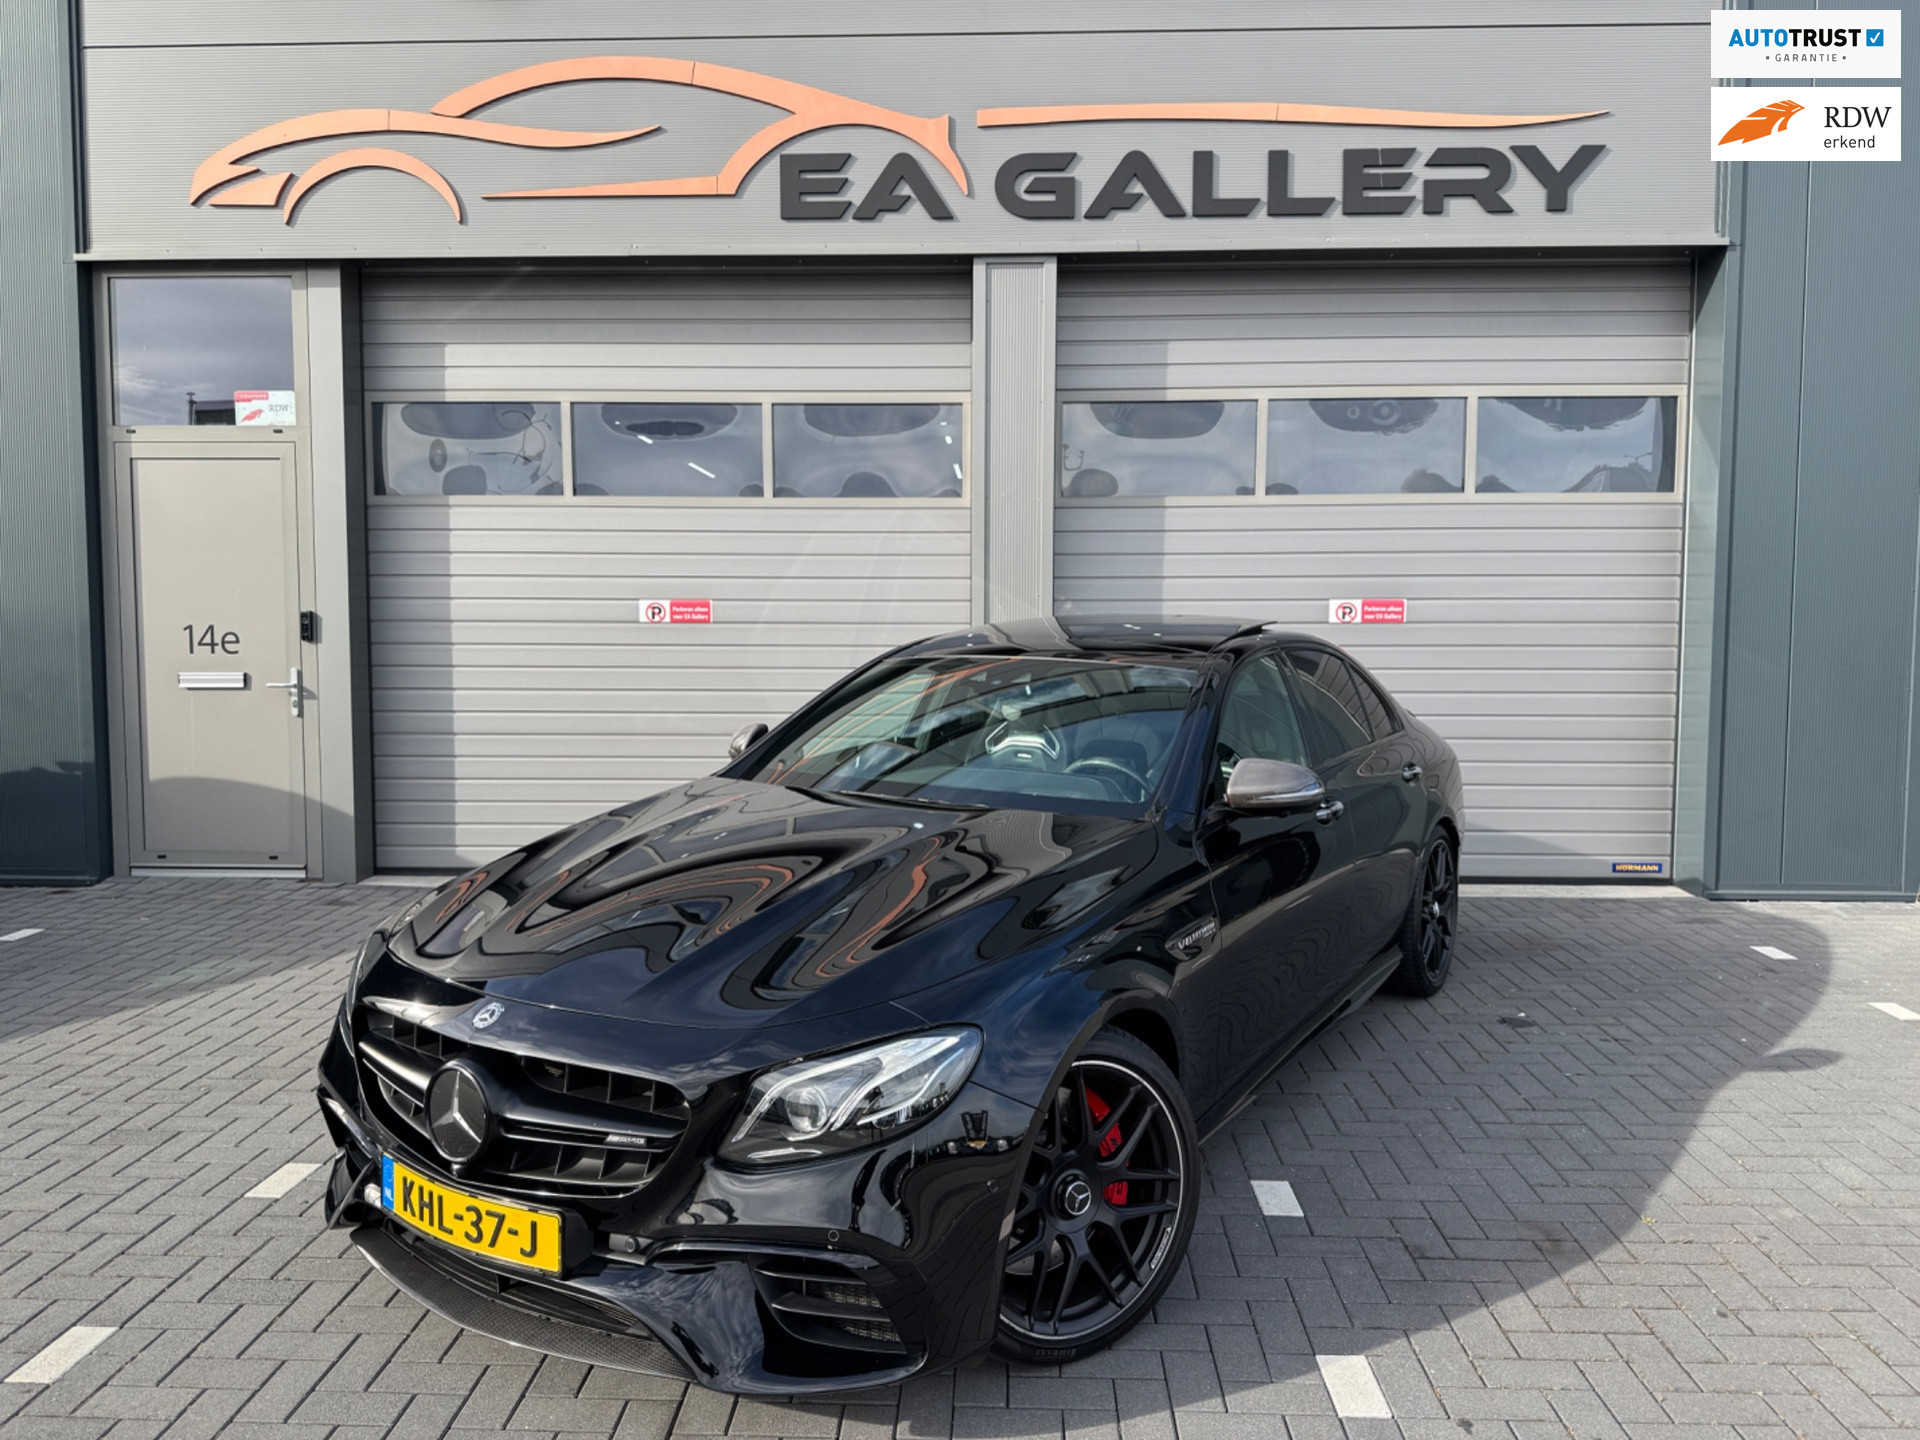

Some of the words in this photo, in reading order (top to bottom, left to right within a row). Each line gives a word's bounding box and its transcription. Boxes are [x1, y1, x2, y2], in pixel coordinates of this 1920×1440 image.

[779, 152, 954, 221] EA
[994, 144, 1606, 221] GALLERY
[268, 404, 289, 412] RDW
[183, 624, 241, 655] 14e
[402, 1175, 538, 1258] KHL-37-J
